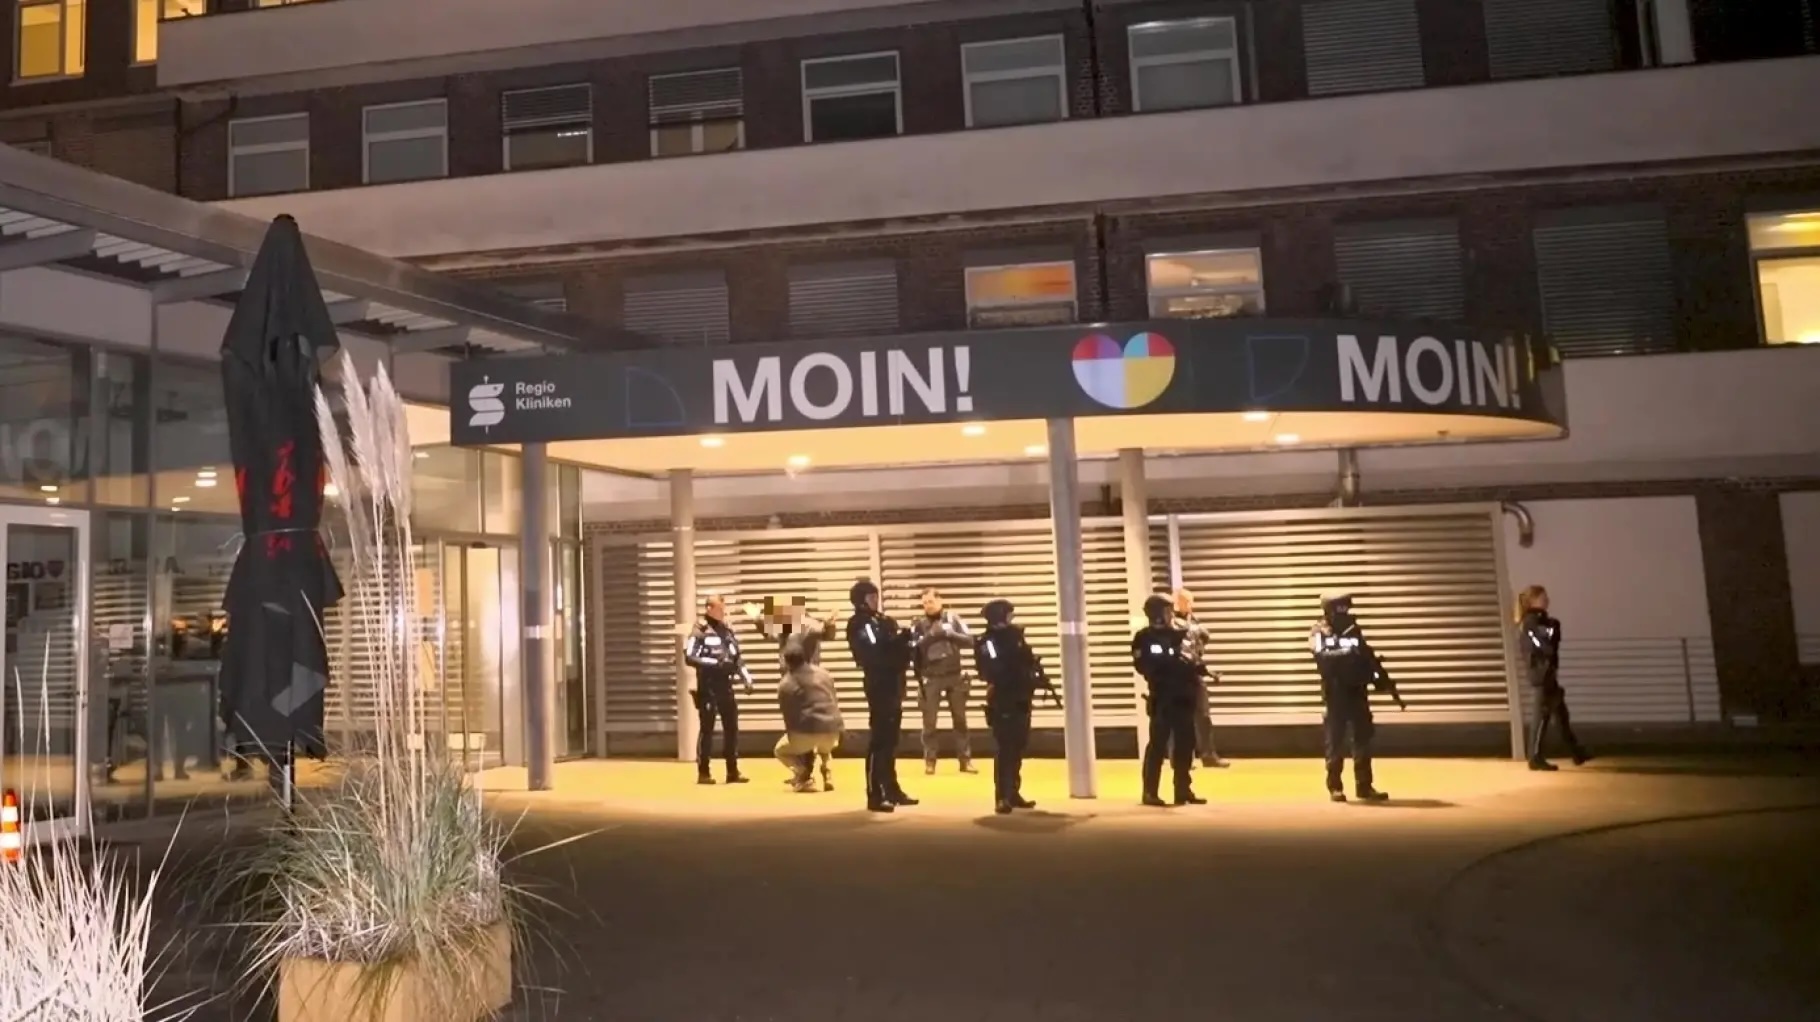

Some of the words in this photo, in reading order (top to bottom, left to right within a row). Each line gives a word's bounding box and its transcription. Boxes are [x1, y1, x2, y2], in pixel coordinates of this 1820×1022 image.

[515, 380, 556, 396] Regio
[712, 345, 974, 424] MOIN!
[1336, 334, 1521, 409] MOIN!
[515, 395, 572, 410] Kliniken
